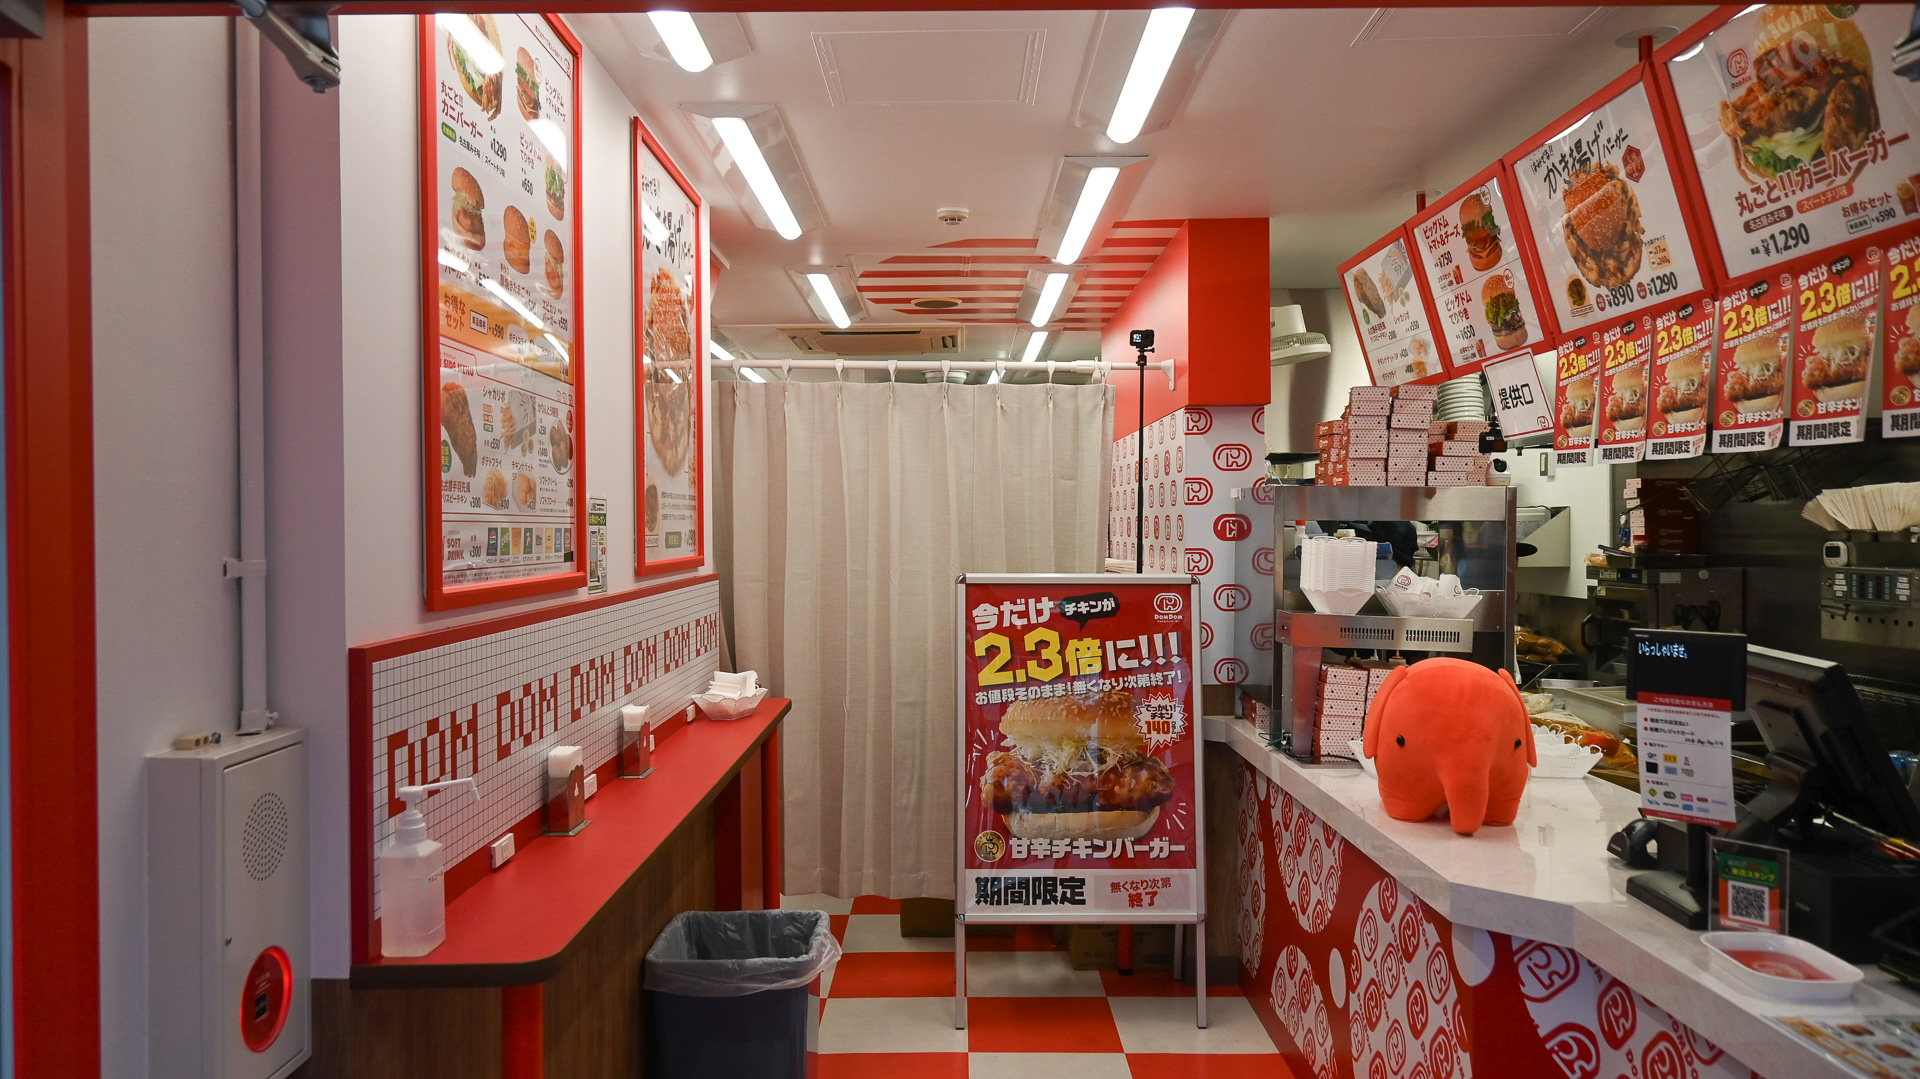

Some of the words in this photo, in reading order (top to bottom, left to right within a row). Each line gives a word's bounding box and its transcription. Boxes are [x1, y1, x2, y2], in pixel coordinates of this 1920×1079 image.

[442, 99, 483, 138] カニバーガー
[1603, 128, 1629, 159] バーガー
[520, 149, 534, 169] てりやき
[1543, 120, 1604, 200] かき揚げ
[1801, 184, 1849, 211] スイートチリ味
[1841, 192, 1892, 219] お得なセット
[1422, 214, 1449, 240] ビッグドム
[1749, 211, 1787, 230] 名古屋みそ味
[1428, 223, 1461, 253] トマト&チーズ
[1762, 222, 1810, 257] ¥1,290
[1438, 250, 1453, 268] ¥750
[1798, 264, 1828, 291] 今だけ
[443, 293, 466, 316] お得な
[1444, 290, 1473, 312] ビッグドム
[1606, 284, 1634, 308] ¥890
[1722, 288, 1748, 311] 今だけ
[1800, 270, 1879, 322] 2.3倍に!!!
[445, 312, 465, 331] セット
[1449, 307, 1470, 326] てりやき
[1656, 310, 1676, 331] 今だけ
[1723, 295, 1792, 340] 2.3倍に!!!
[1460, 324, 1475, 341] ¥650
[1604, 326, 1620, 345] 今だけ
[1657, 317, 1713, 357] 2.3倍に!!!
[1558, 340, 1574, 357] 今だけ
[1605, 334, 1651, 369] 2.3倍に!!!
[1499, 383, 1534, 411] 提供口
[1719, 431, 1766, 448] 期間限定
[1796, 421, 1852, 440] 期間限定
[1557, 452, 1587, 464] 期間限定
[1602, 446, 1634, 460] 期間限定
[1652, 440, 1690, 455] 期間限定
[481, 455, 502, 468] ポテトフライ
[447, 538, 461, 549] SOFT
[447, 550, 464, 561] DRINK
[972, 596, 1054, 631] 今だけ
[1064, 598, 1116, 616] チキンが
[974, 626, 1182, 687] 2.3倍に!!!
[1638, 641, 1688, 658] いらっしゃいませ。
[975, 670, 1182, 705] お値段そのまま!無くなり次第終了!
[387, 703, 478, 818] DOM
[497, 673, 558, 762] DOM
[571, 652, 615, 723] DOM
[624, 635, 657, 695] DOM
[664, 622, 690, 674] DOM
[696, 612, 719, 657] DOM
[1145, 721, 1170, 734] 140
[1009, 837, 1186, 859] 甘辛チキンバーガー
[975, 876, 1086, 905] 期間限定
[1110, 877, 1172, 893] 無くなり次第
[1128, 891, 1158, 908] 終了
